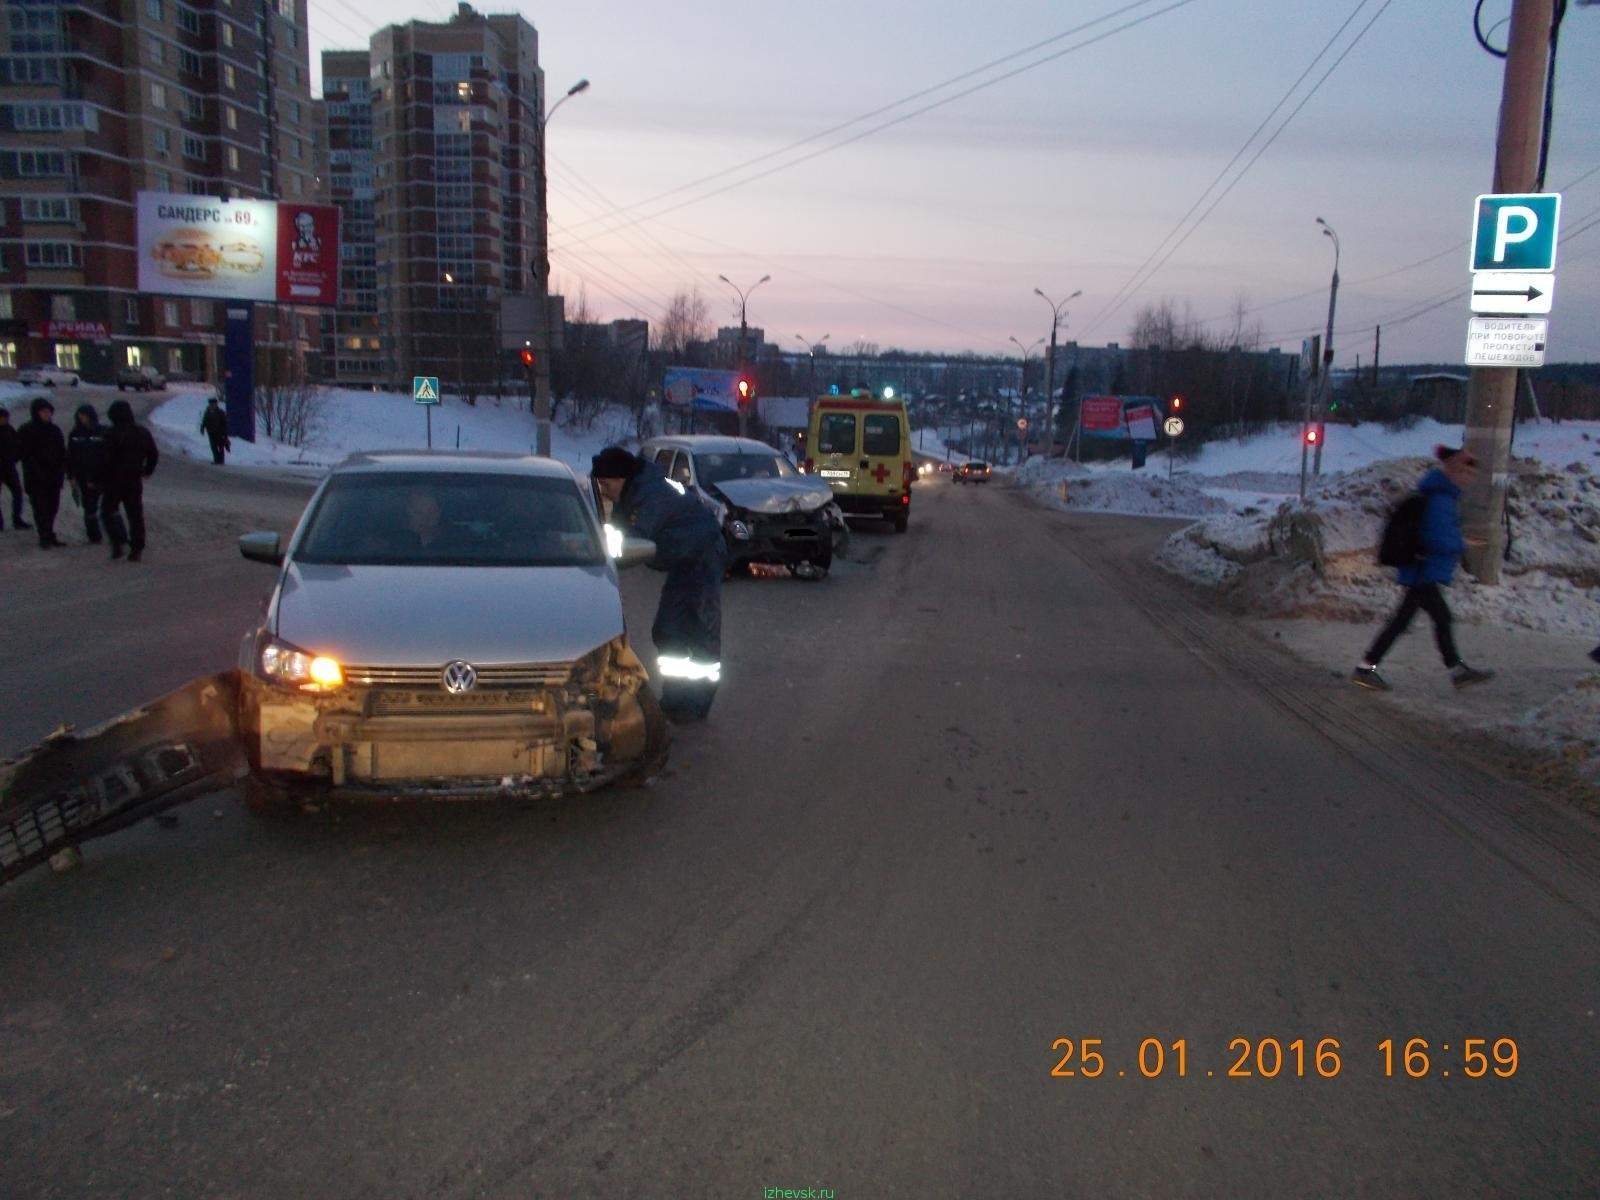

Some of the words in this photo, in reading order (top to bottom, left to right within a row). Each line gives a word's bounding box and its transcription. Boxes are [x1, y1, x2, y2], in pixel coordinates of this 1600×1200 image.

[158, 205, 220, 222] САНДЕРС
[235, 211, 251, 225] 69
[1493, 206, 1538, 262] P
[293, 253, 317, 267] KFC
[1484, 322, 1536, 331] ВОДИТЕЛЬ
[1471, 332, 1490, 340] ПРИ
[1474, 352, 1535, 361] ПЕШЕХОДОВ
